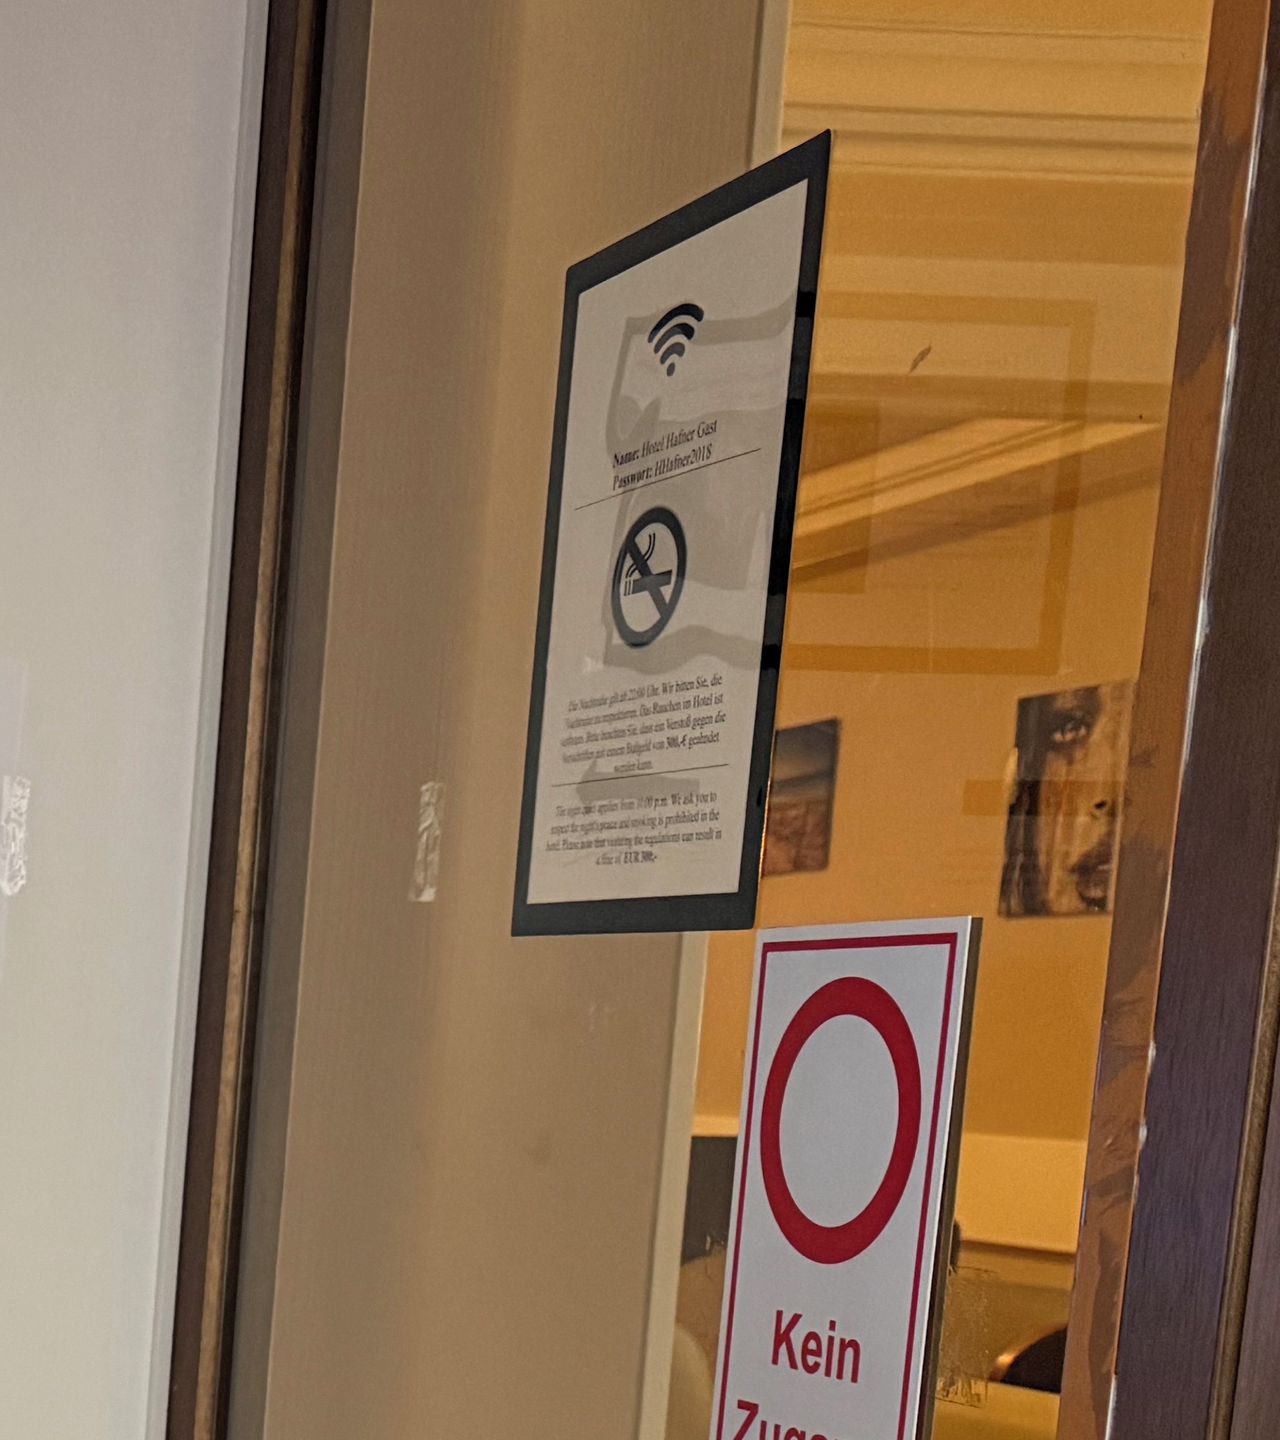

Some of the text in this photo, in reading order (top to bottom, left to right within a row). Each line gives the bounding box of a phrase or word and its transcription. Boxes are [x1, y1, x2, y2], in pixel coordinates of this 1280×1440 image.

[641, 434, 665, 458] Hotel
[697, 420, 718, 439] Gast
[771, 1309, 861, 1384] Kein
